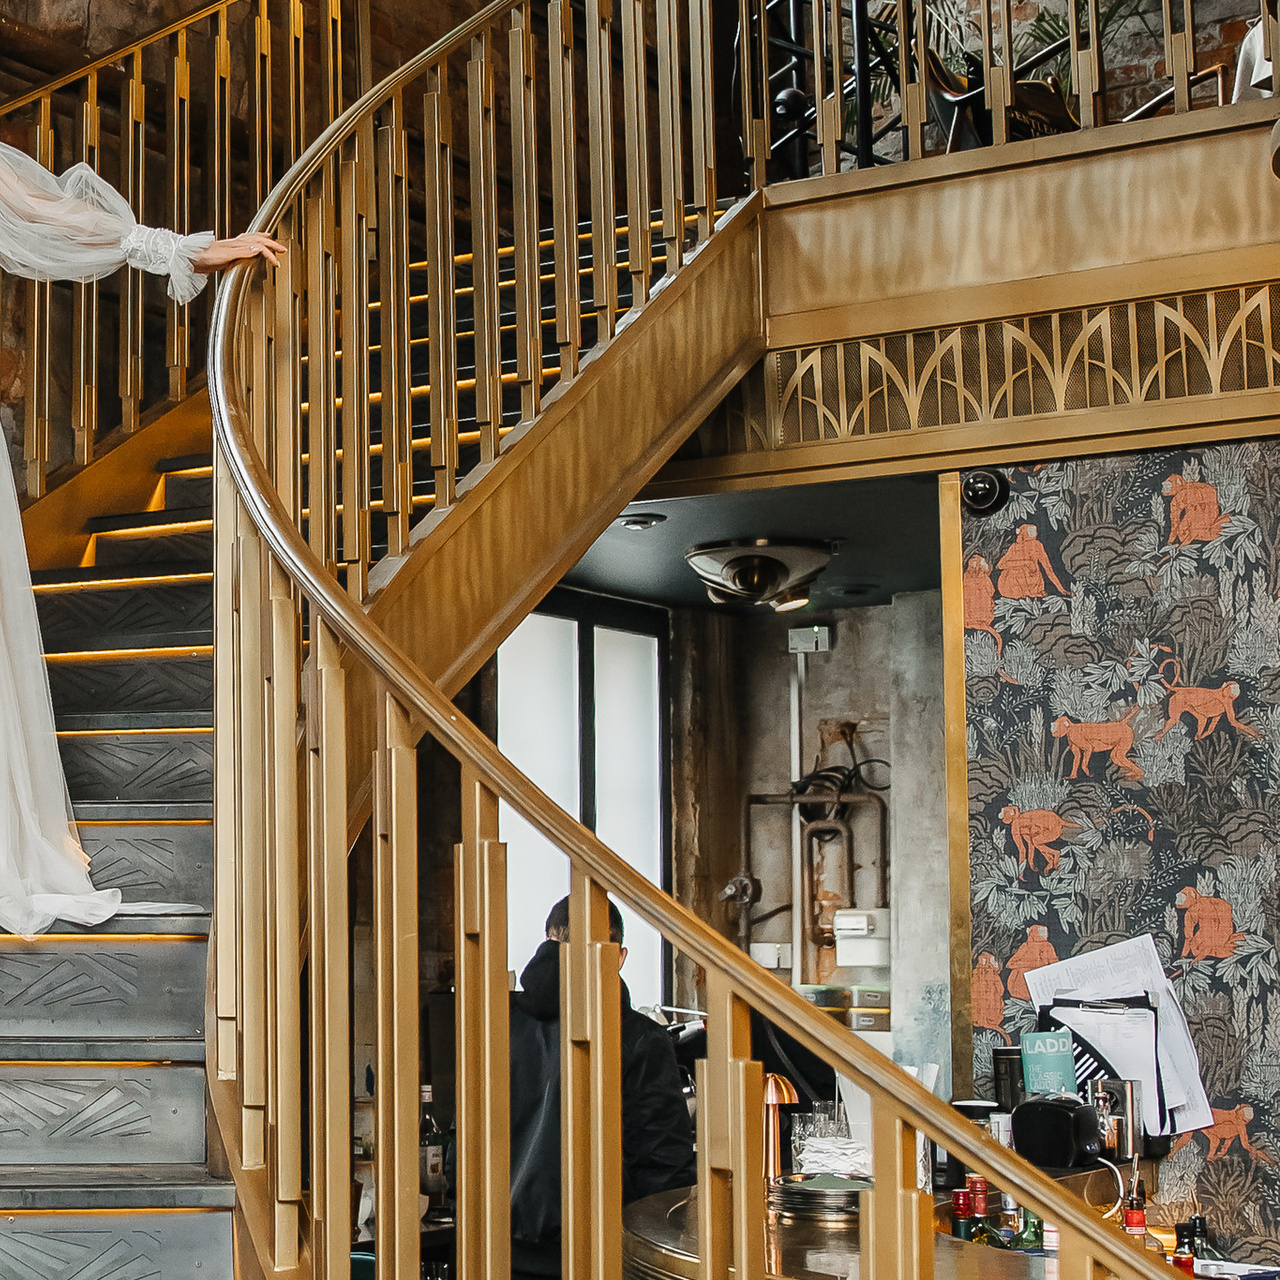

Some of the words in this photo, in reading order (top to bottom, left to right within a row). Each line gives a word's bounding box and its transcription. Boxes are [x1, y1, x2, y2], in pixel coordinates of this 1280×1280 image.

[1028, 1064, 1042, 1073] THE
[1028, 1071, 1063, 1081] CLASSIC
[1029, 1080, 1060, 1090] LADDIE
